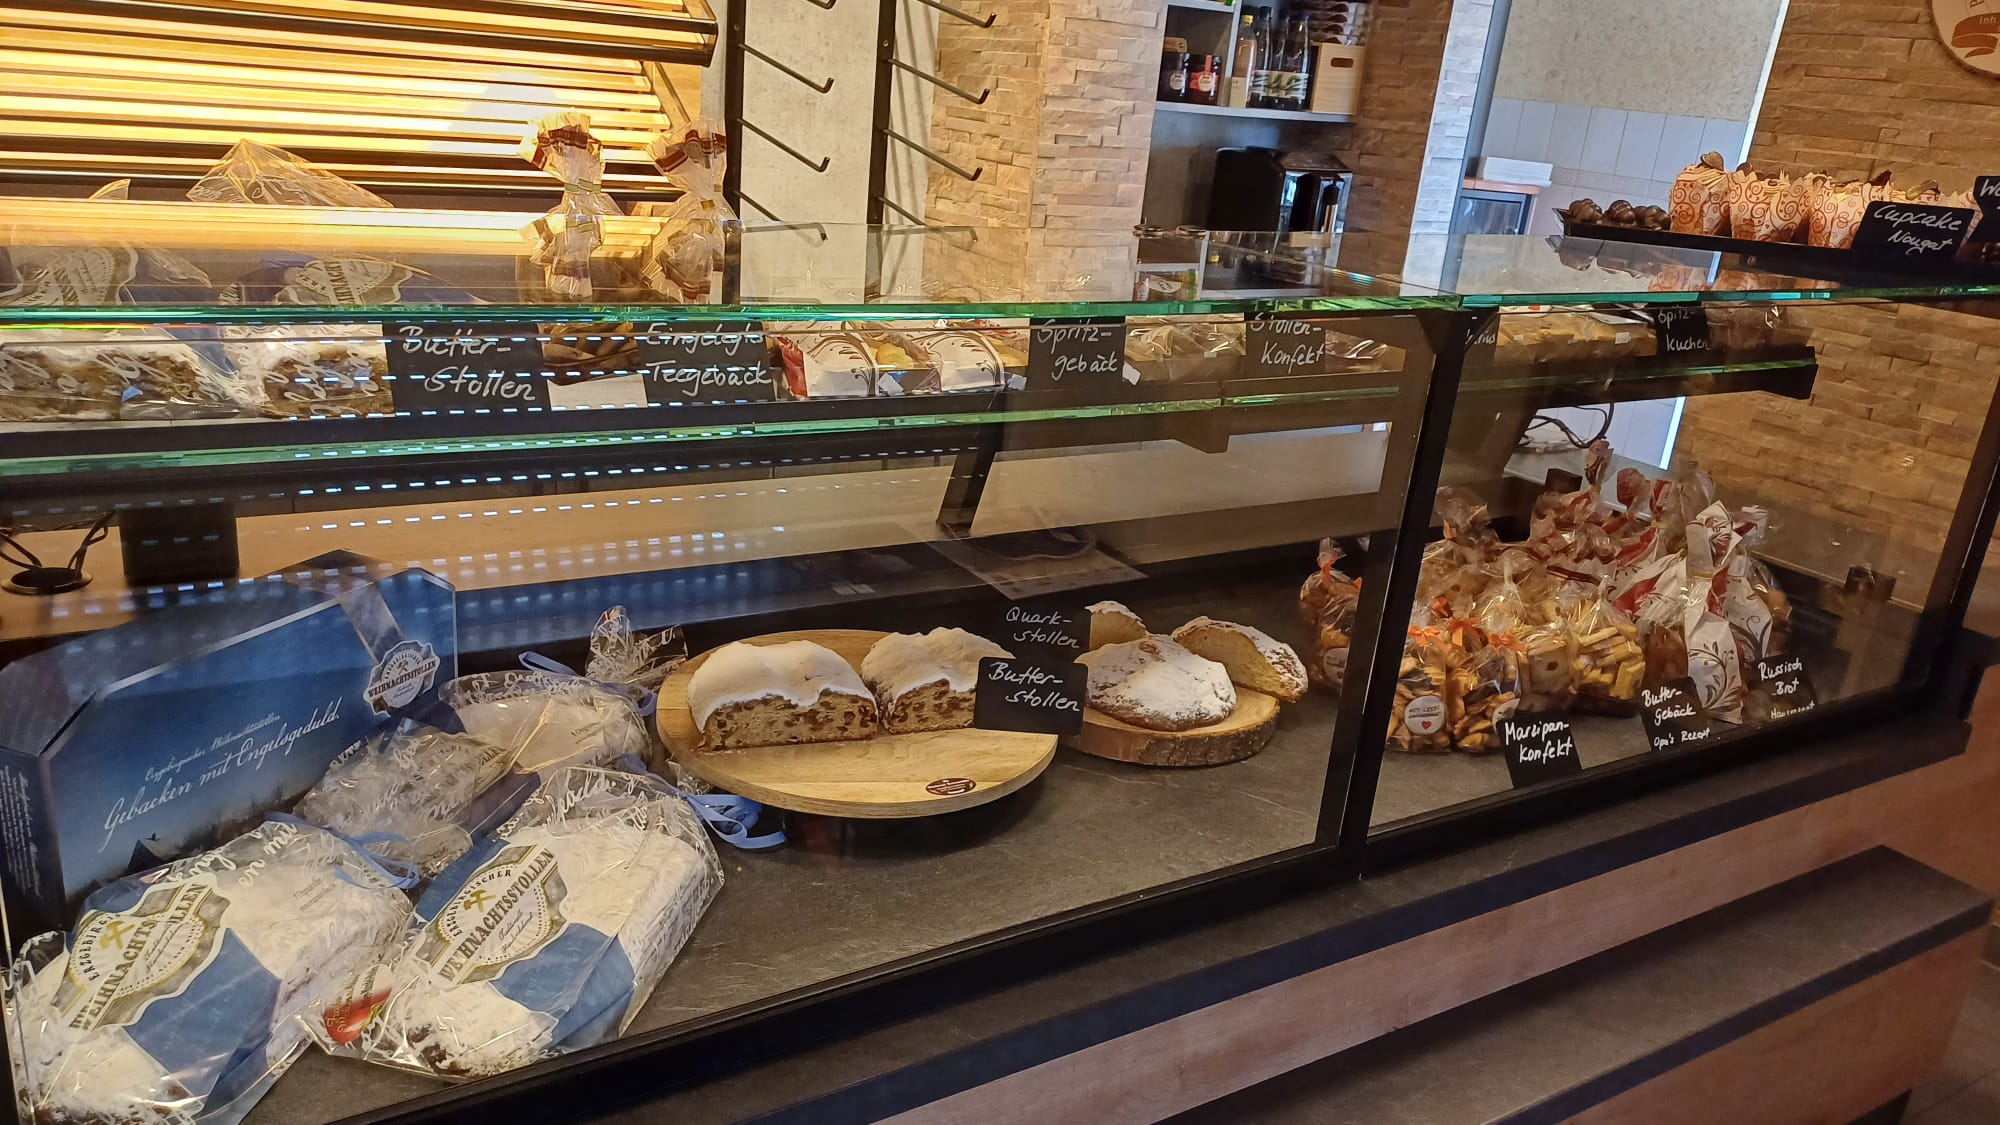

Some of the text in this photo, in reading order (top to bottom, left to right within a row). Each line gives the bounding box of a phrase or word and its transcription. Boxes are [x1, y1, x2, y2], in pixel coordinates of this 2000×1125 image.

[1874, 205, 1963, 230] Cupcake
[1888, 230, 1953, 256] Nougat
[399, 325, 512, 358] Butter-
[1037, 318, 1112, 355] Spritz-
[1051, 350, 1118, 381] gebäck
[1006, 606, 1072, 625] Quark-
[367, 659, 437, 698] WEIHNACHTSSTOLLEN
[988, 661, 1064, 685] Butter-
[1757, 657, 1803, 682] Russisch
[1641, 686, 1683, 708] Butter-
[1504, 720, 1570, 746] Marzipan-
[101, 777, 193, 852] Gebacken
[199, 751, 236, 786] mit
[438, 847, 556, 982] WEIHNACHTSSTOLLEN
